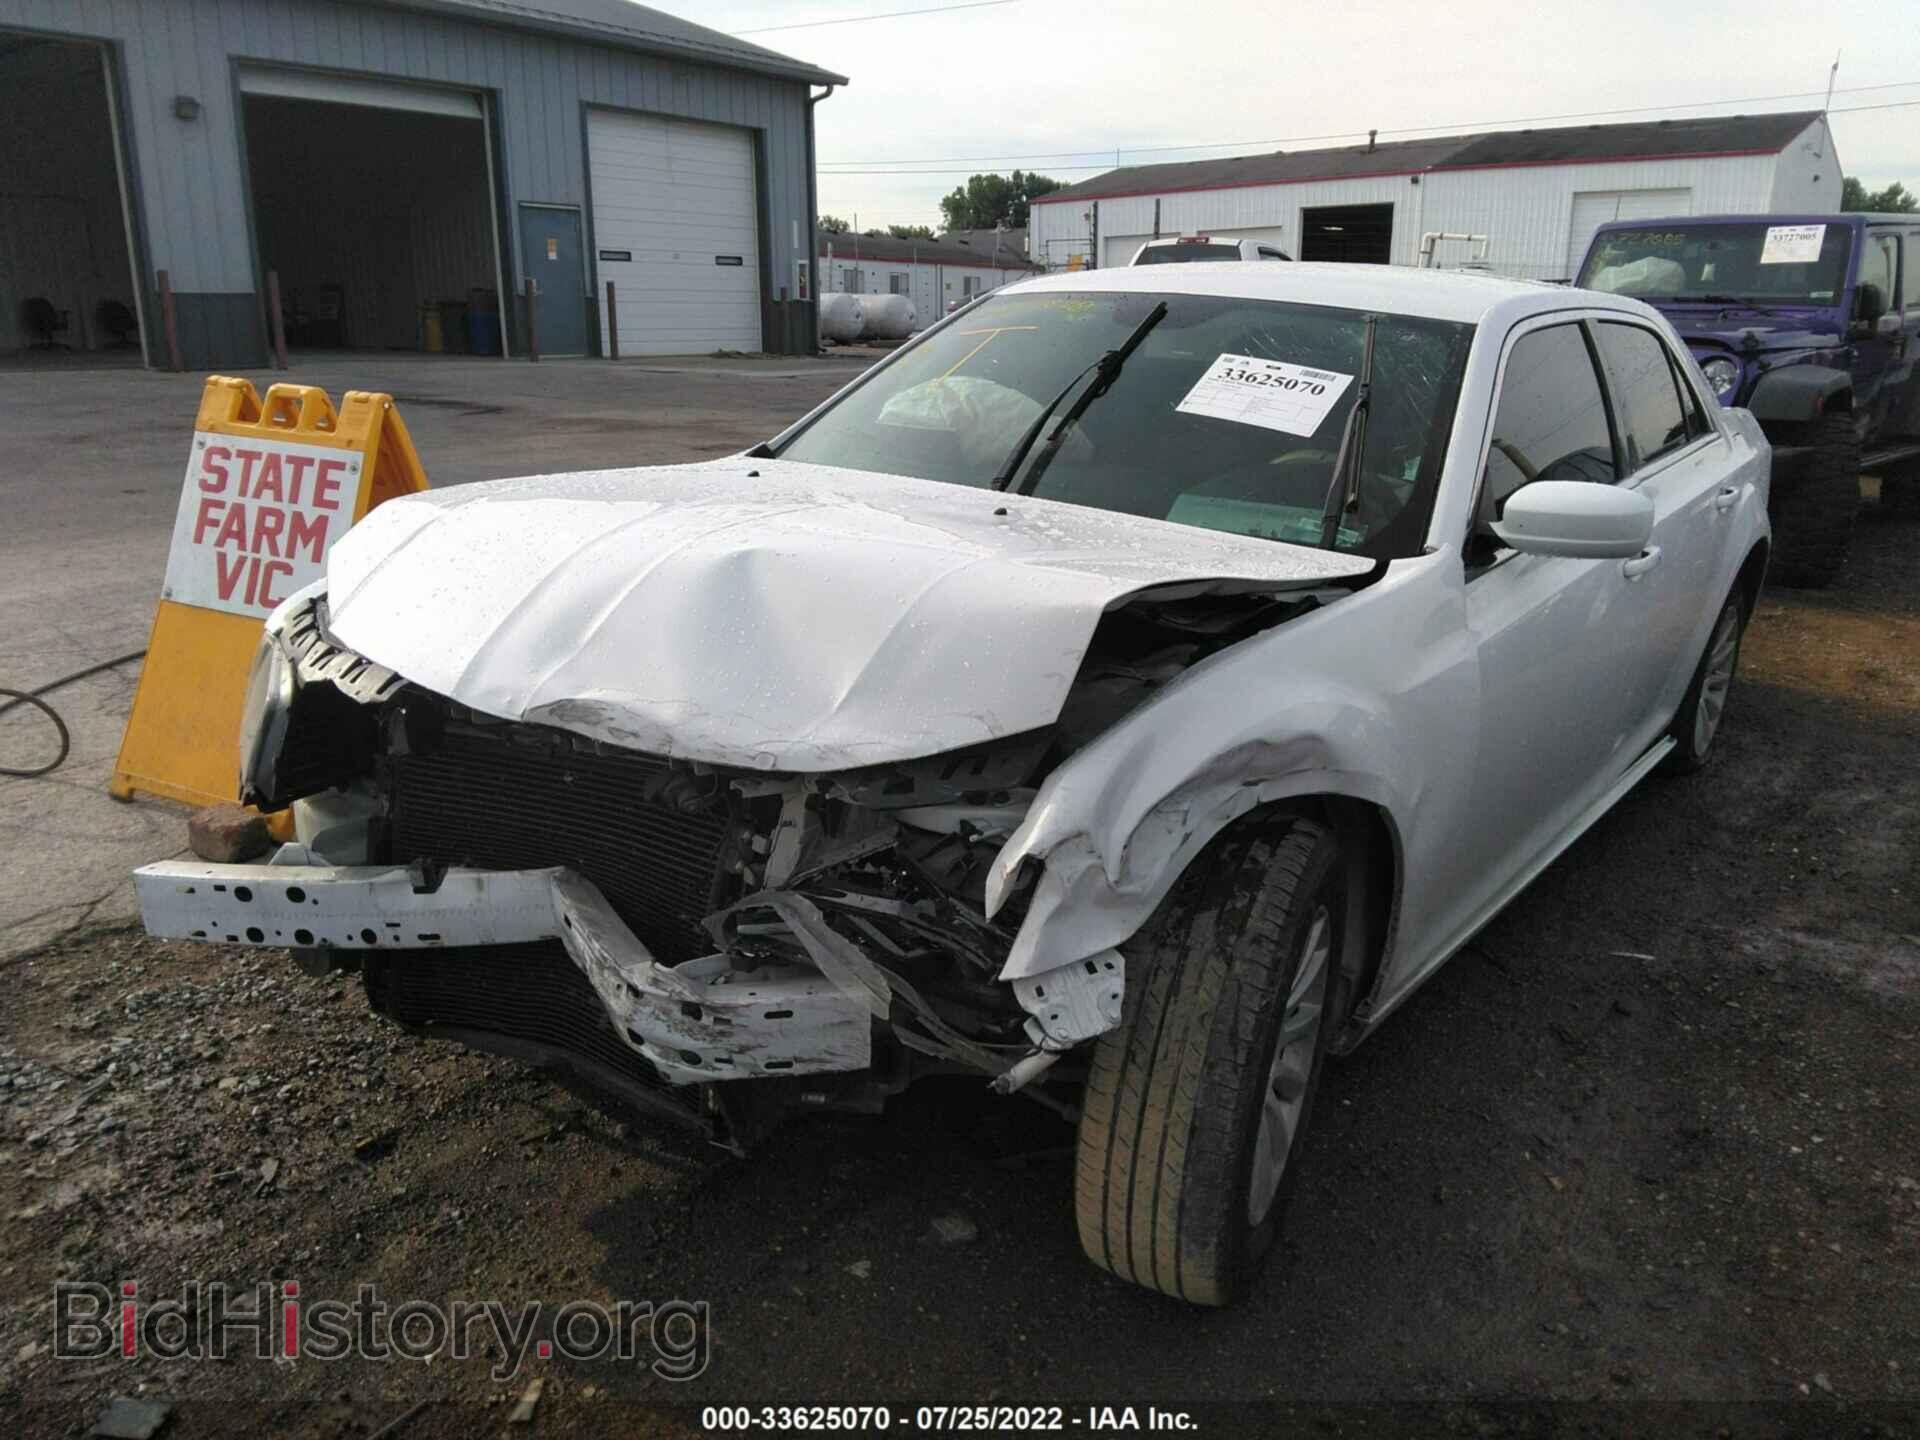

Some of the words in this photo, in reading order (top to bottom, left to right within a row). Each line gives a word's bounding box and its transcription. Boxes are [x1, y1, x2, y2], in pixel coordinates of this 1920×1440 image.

[1217, 368, 1326, 395] 33625070
[199, 446, 347, 510] STATE
[193, 499, 329, 564] FARM
[216, 551, 294, 610] VIC
